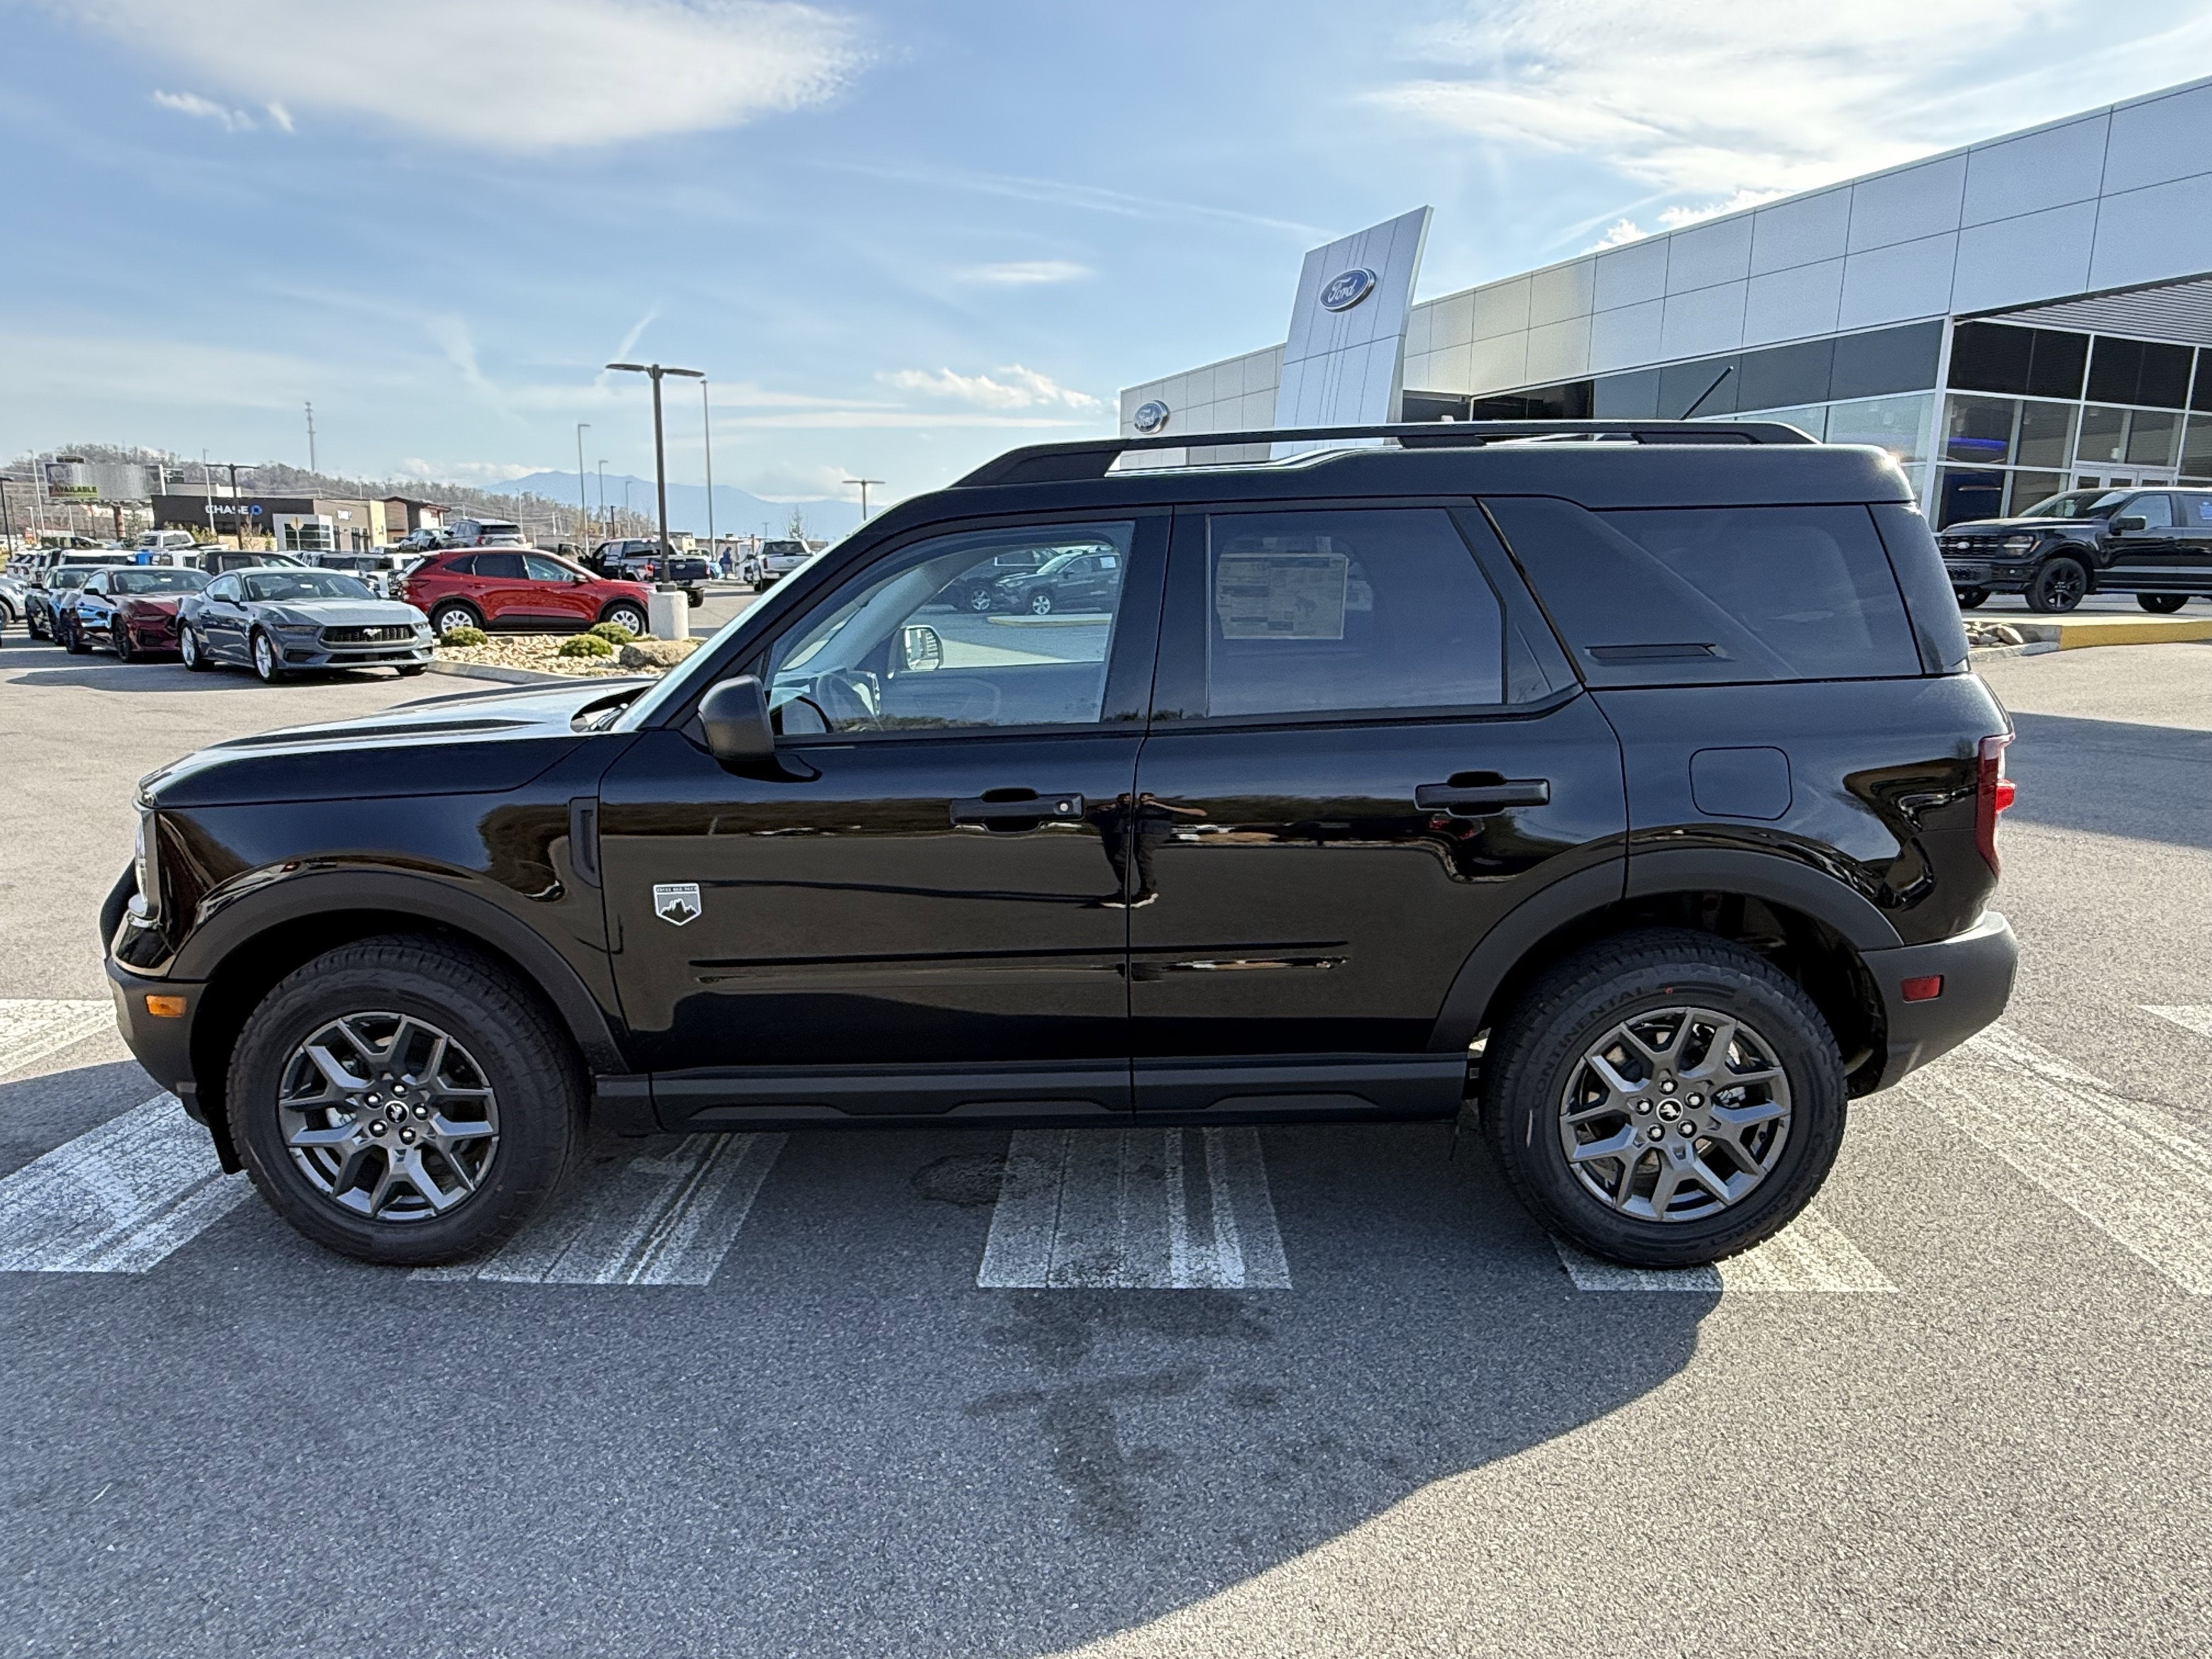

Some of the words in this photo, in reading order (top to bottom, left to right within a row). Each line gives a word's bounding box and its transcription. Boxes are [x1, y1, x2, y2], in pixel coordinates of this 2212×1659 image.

[1328, 276, 1358, 303] Ford
[1135, 408, 1155, 428] Ford
[205, 504, 249, 514] CHASE
